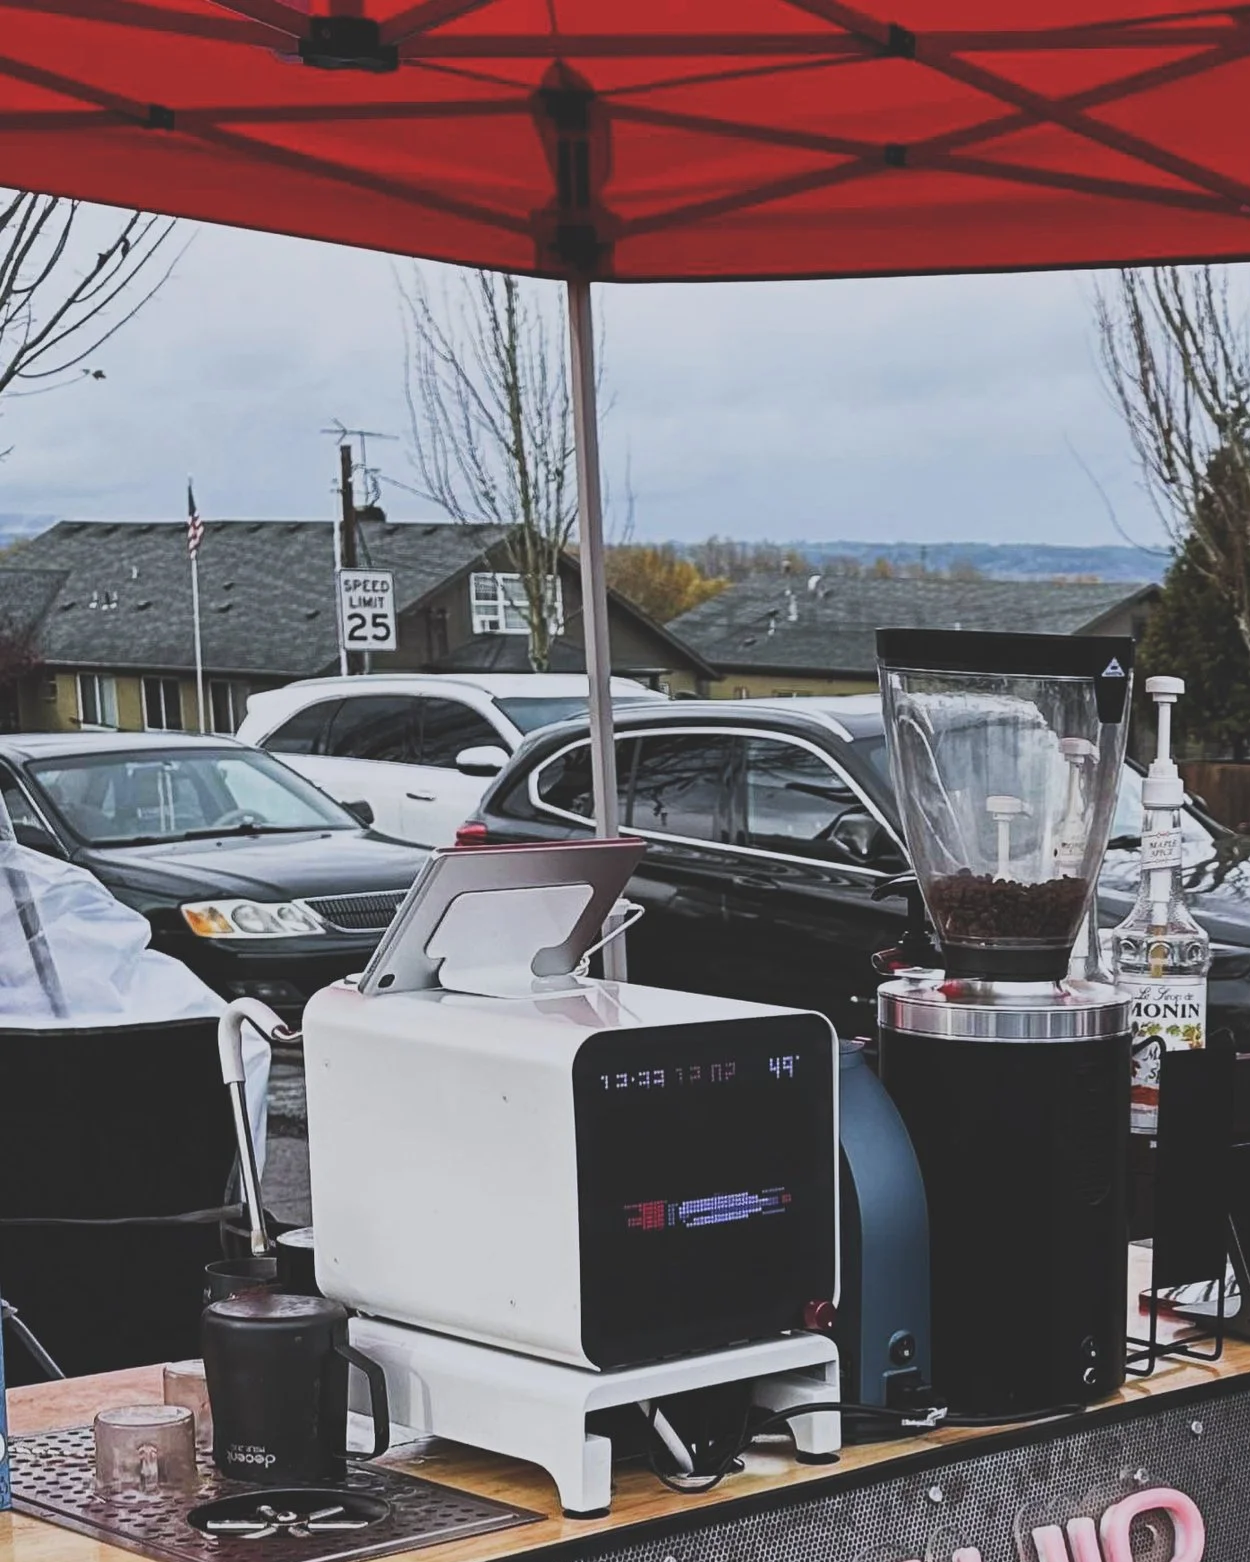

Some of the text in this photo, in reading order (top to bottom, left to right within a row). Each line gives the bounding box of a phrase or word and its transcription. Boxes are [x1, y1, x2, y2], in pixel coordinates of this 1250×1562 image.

[343, 579, 390, 593] SPEED
[349, 595, 385, 609] LIMIT
[347, 612, 391, 641] 25
[227, 1449, 276, 1469] decent
